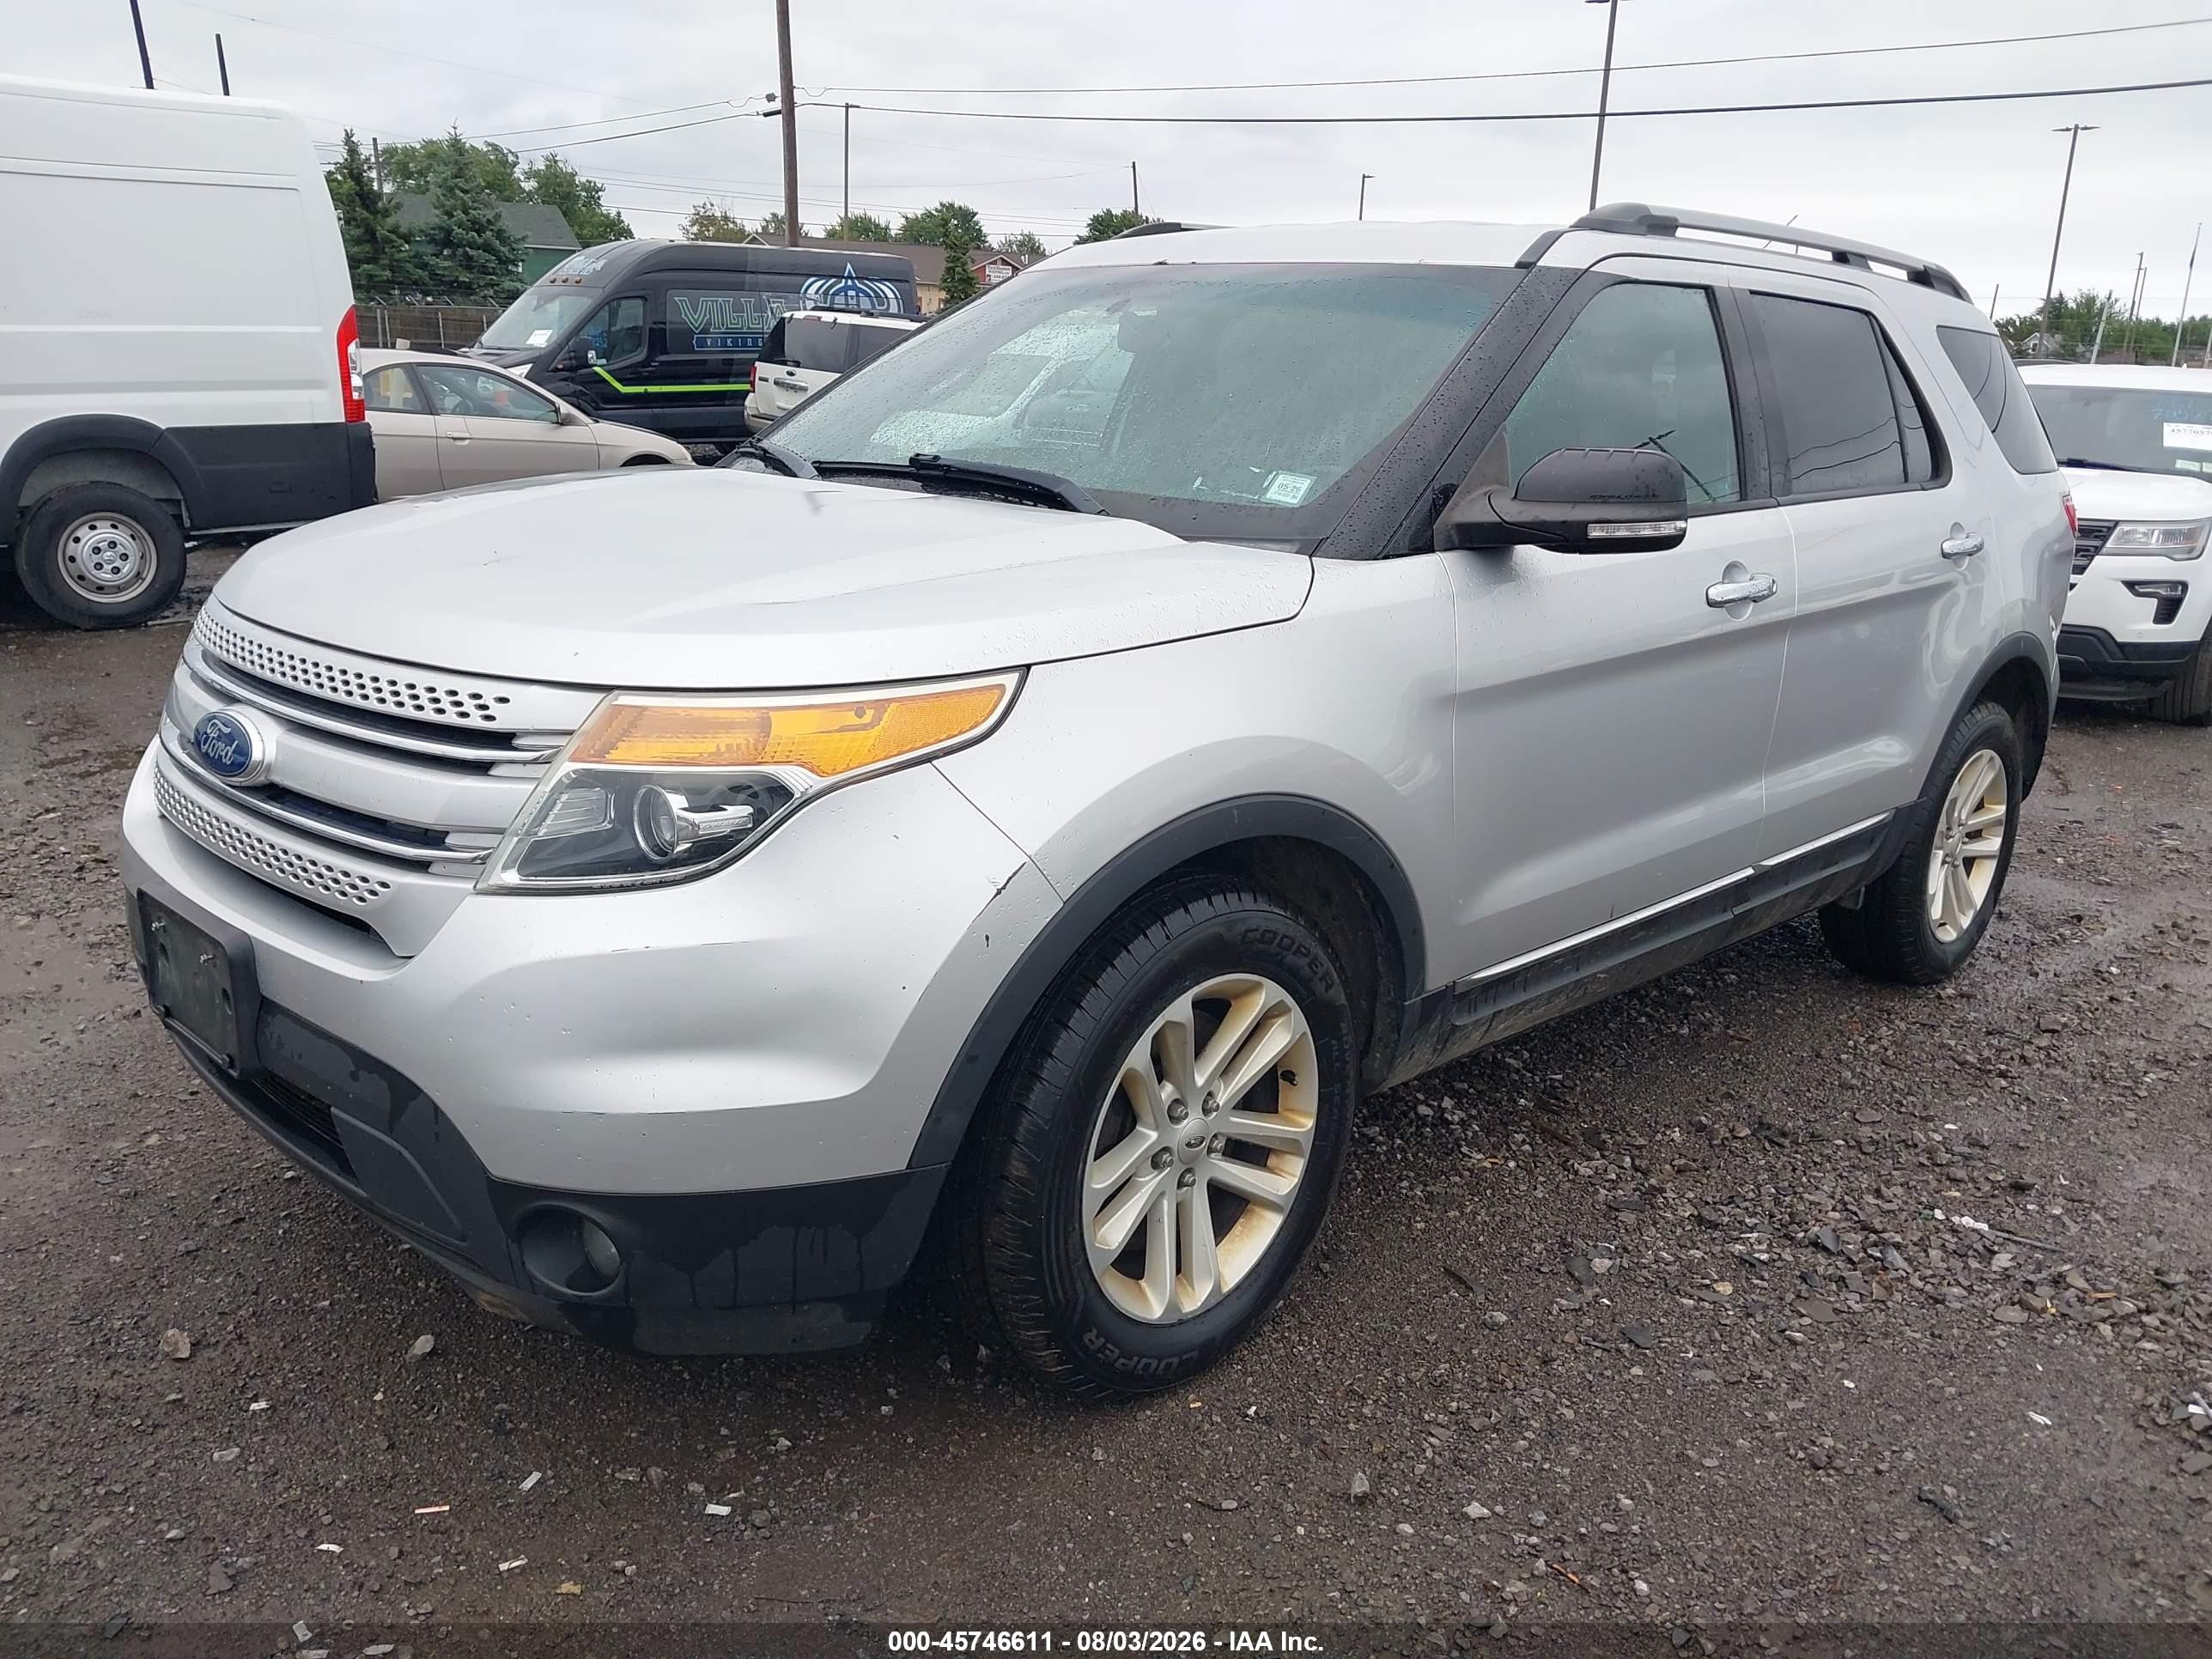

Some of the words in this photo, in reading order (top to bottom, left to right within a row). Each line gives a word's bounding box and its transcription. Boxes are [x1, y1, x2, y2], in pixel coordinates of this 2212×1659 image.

[674, 297, 787, 333] VILLA
[200, 720, 239, 765] Ford
[1240, 927, 1334, 994] COOPER
